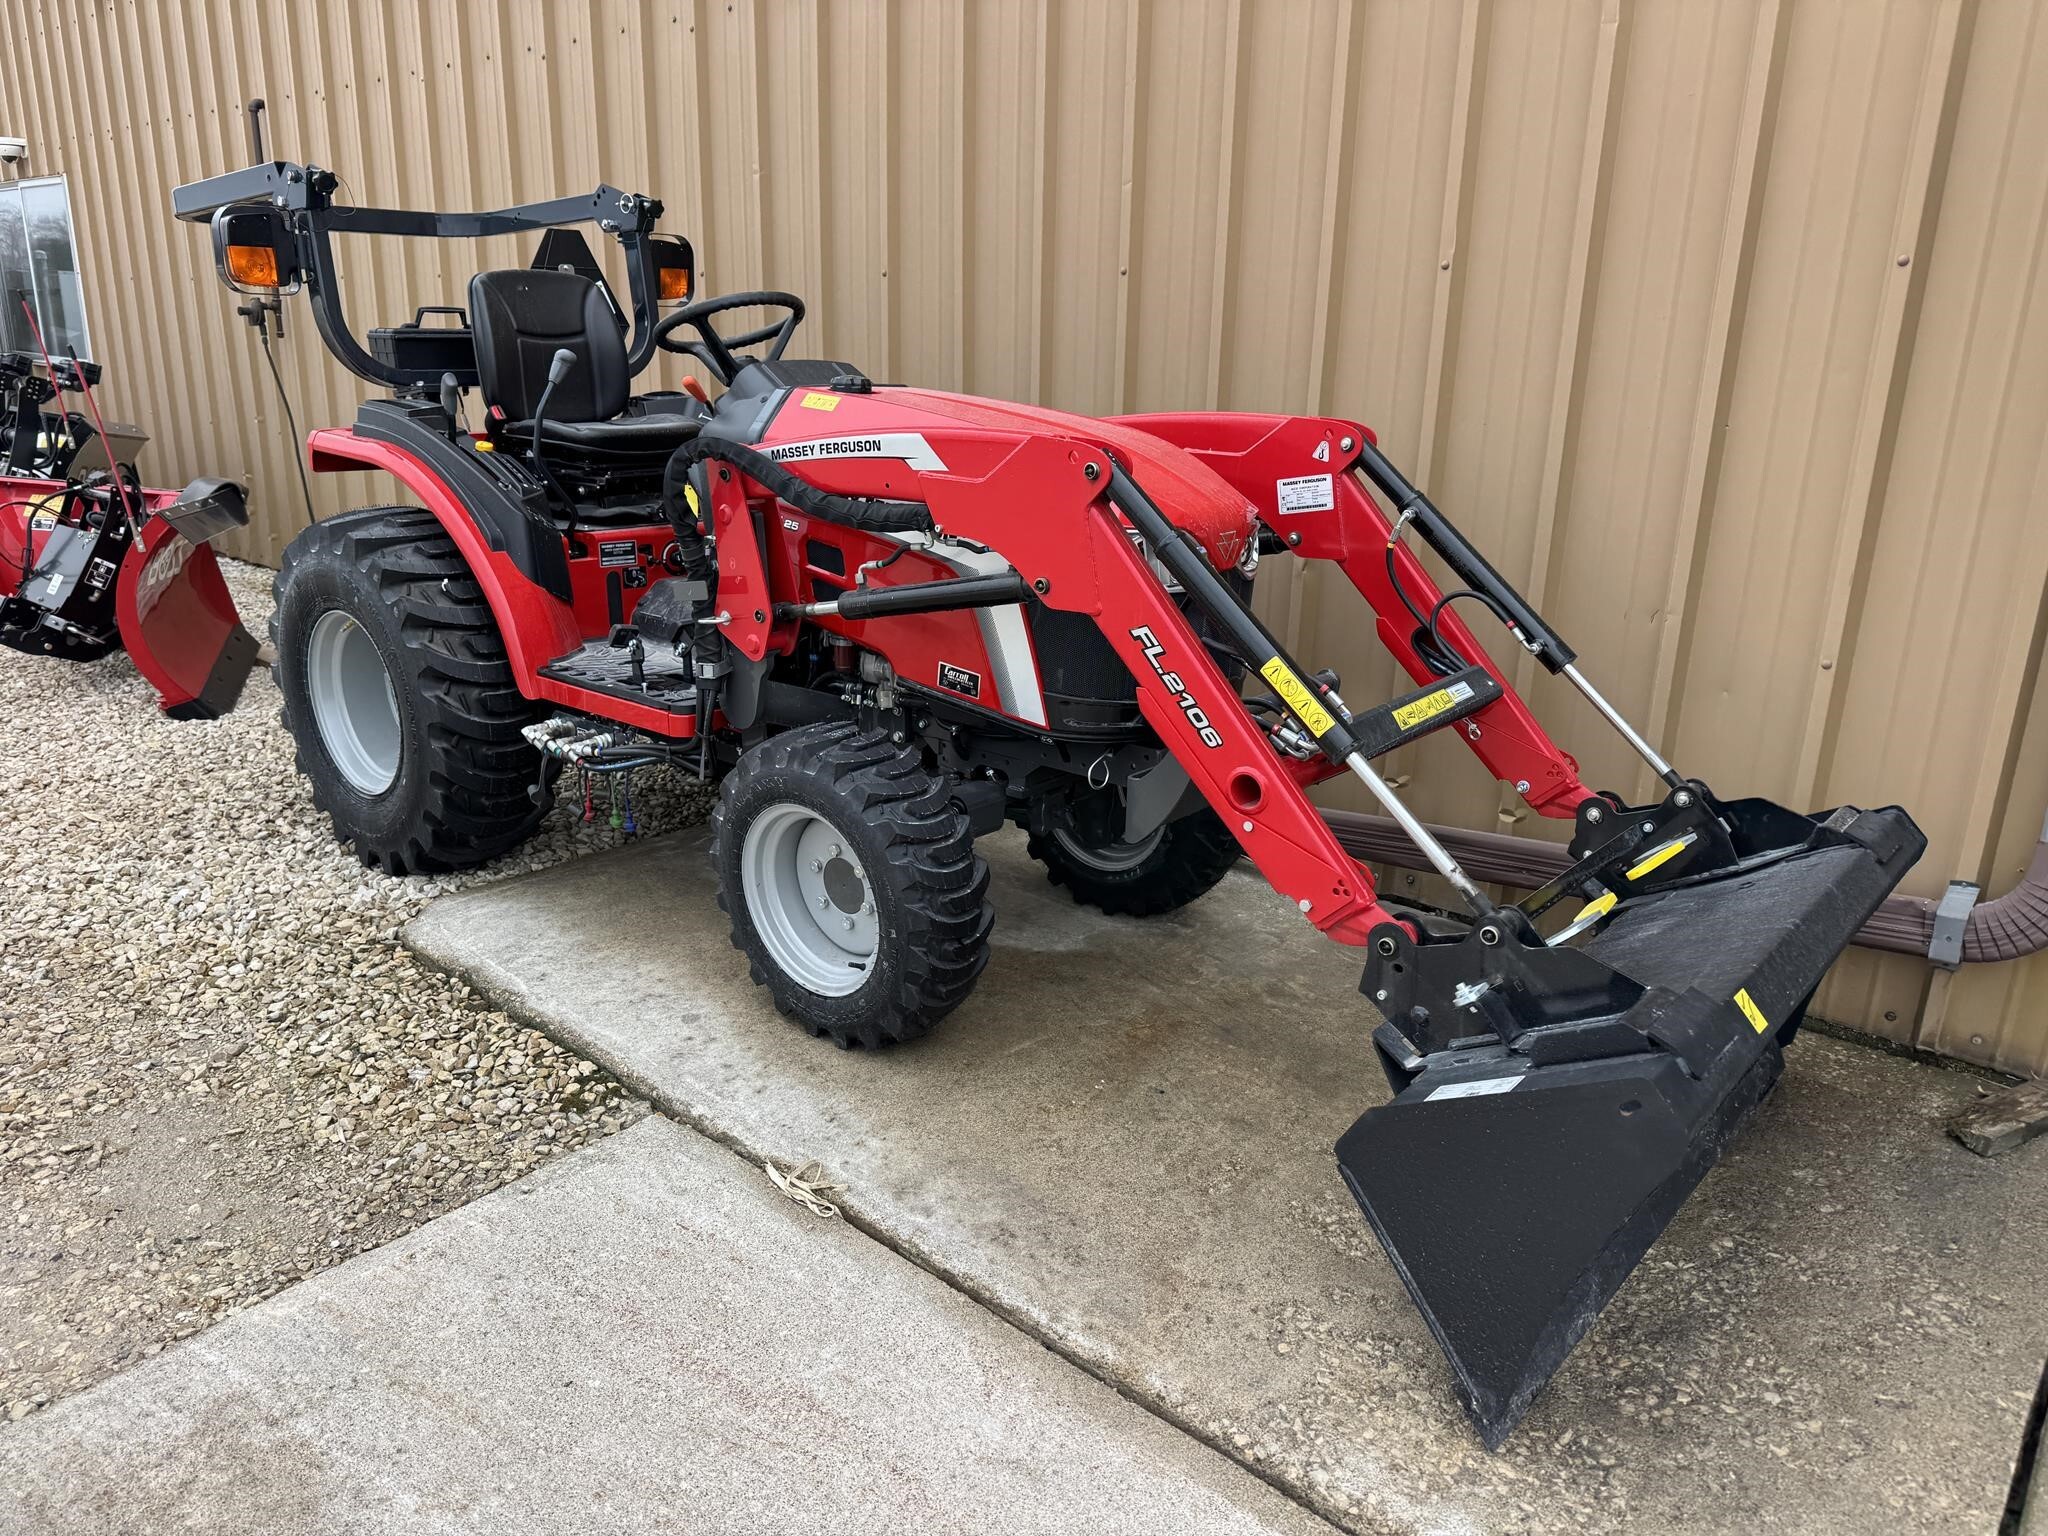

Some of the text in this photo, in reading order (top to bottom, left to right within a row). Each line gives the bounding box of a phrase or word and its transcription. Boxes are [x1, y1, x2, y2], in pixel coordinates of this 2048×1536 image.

[771, 440, 882, 461] MASSEY FERGUSON
[783, 519, 800, 531] 25
